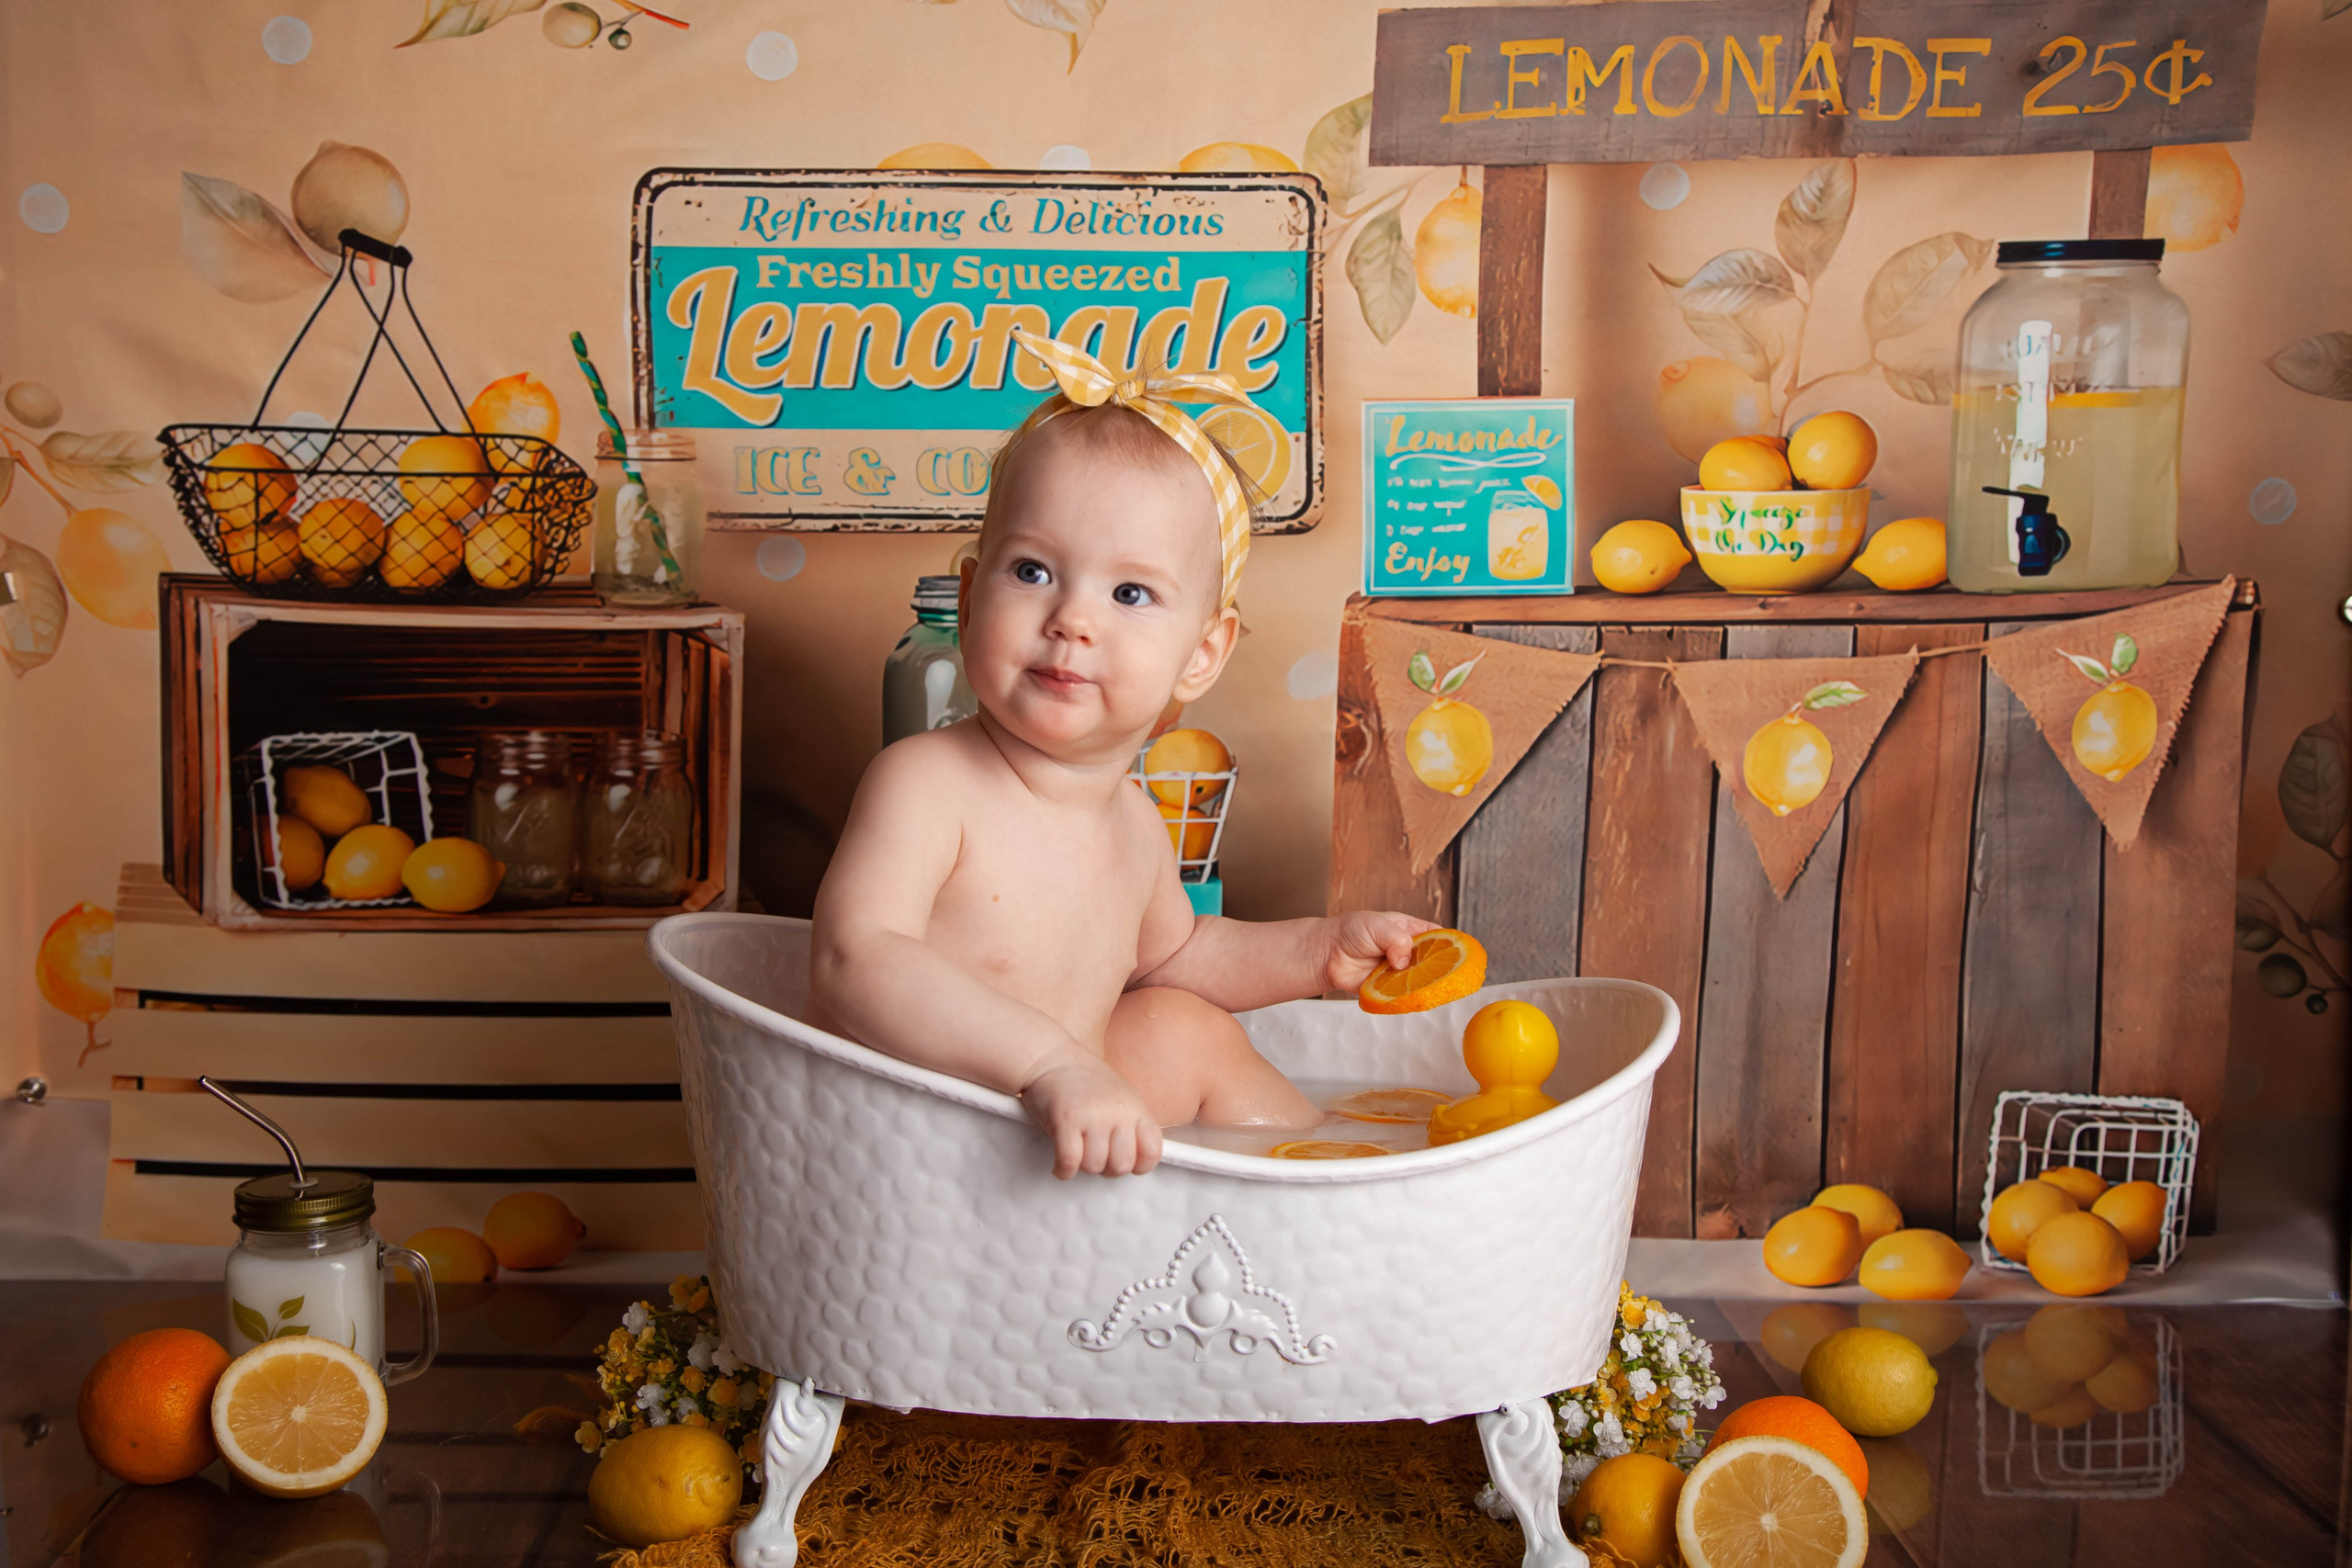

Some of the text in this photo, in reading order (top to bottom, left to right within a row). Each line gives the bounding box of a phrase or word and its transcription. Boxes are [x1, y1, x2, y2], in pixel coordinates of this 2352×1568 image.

[1440, 34, 2215, 125] LEMONADE 25¢
[739, 195, 1225, 243] Refreshing & Delicious
[755, 254, 1182, 299] Freshly Squeezed
[666, 265, 1288, 427] Lemonade
[1385, 414, 1564, 457] Lemonade
[733, 446, 822, 496] ICE
[842, 446, 896, 497] &
[1385, 542, 1471, 584] Enjoy
